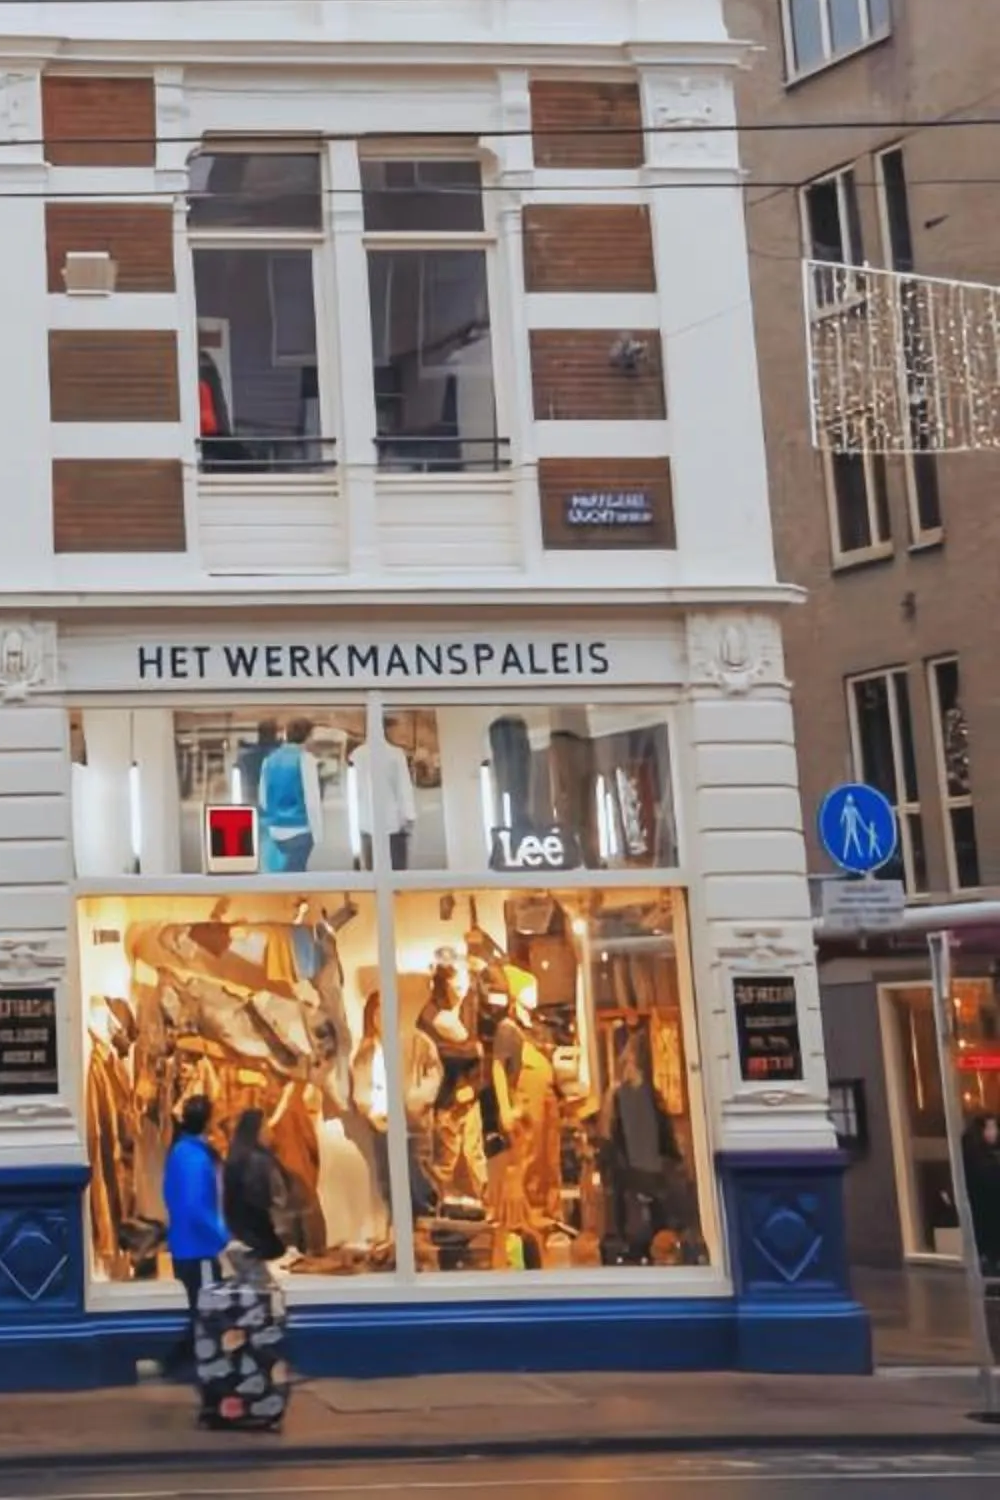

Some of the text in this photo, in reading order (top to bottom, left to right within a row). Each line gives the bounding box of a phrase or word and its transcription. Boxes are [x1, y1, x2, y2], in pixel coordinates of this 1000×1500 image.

[138, 642, 609, 679] HET WERKMANSPALEIS
[498, 830, 564, 867] Lee
